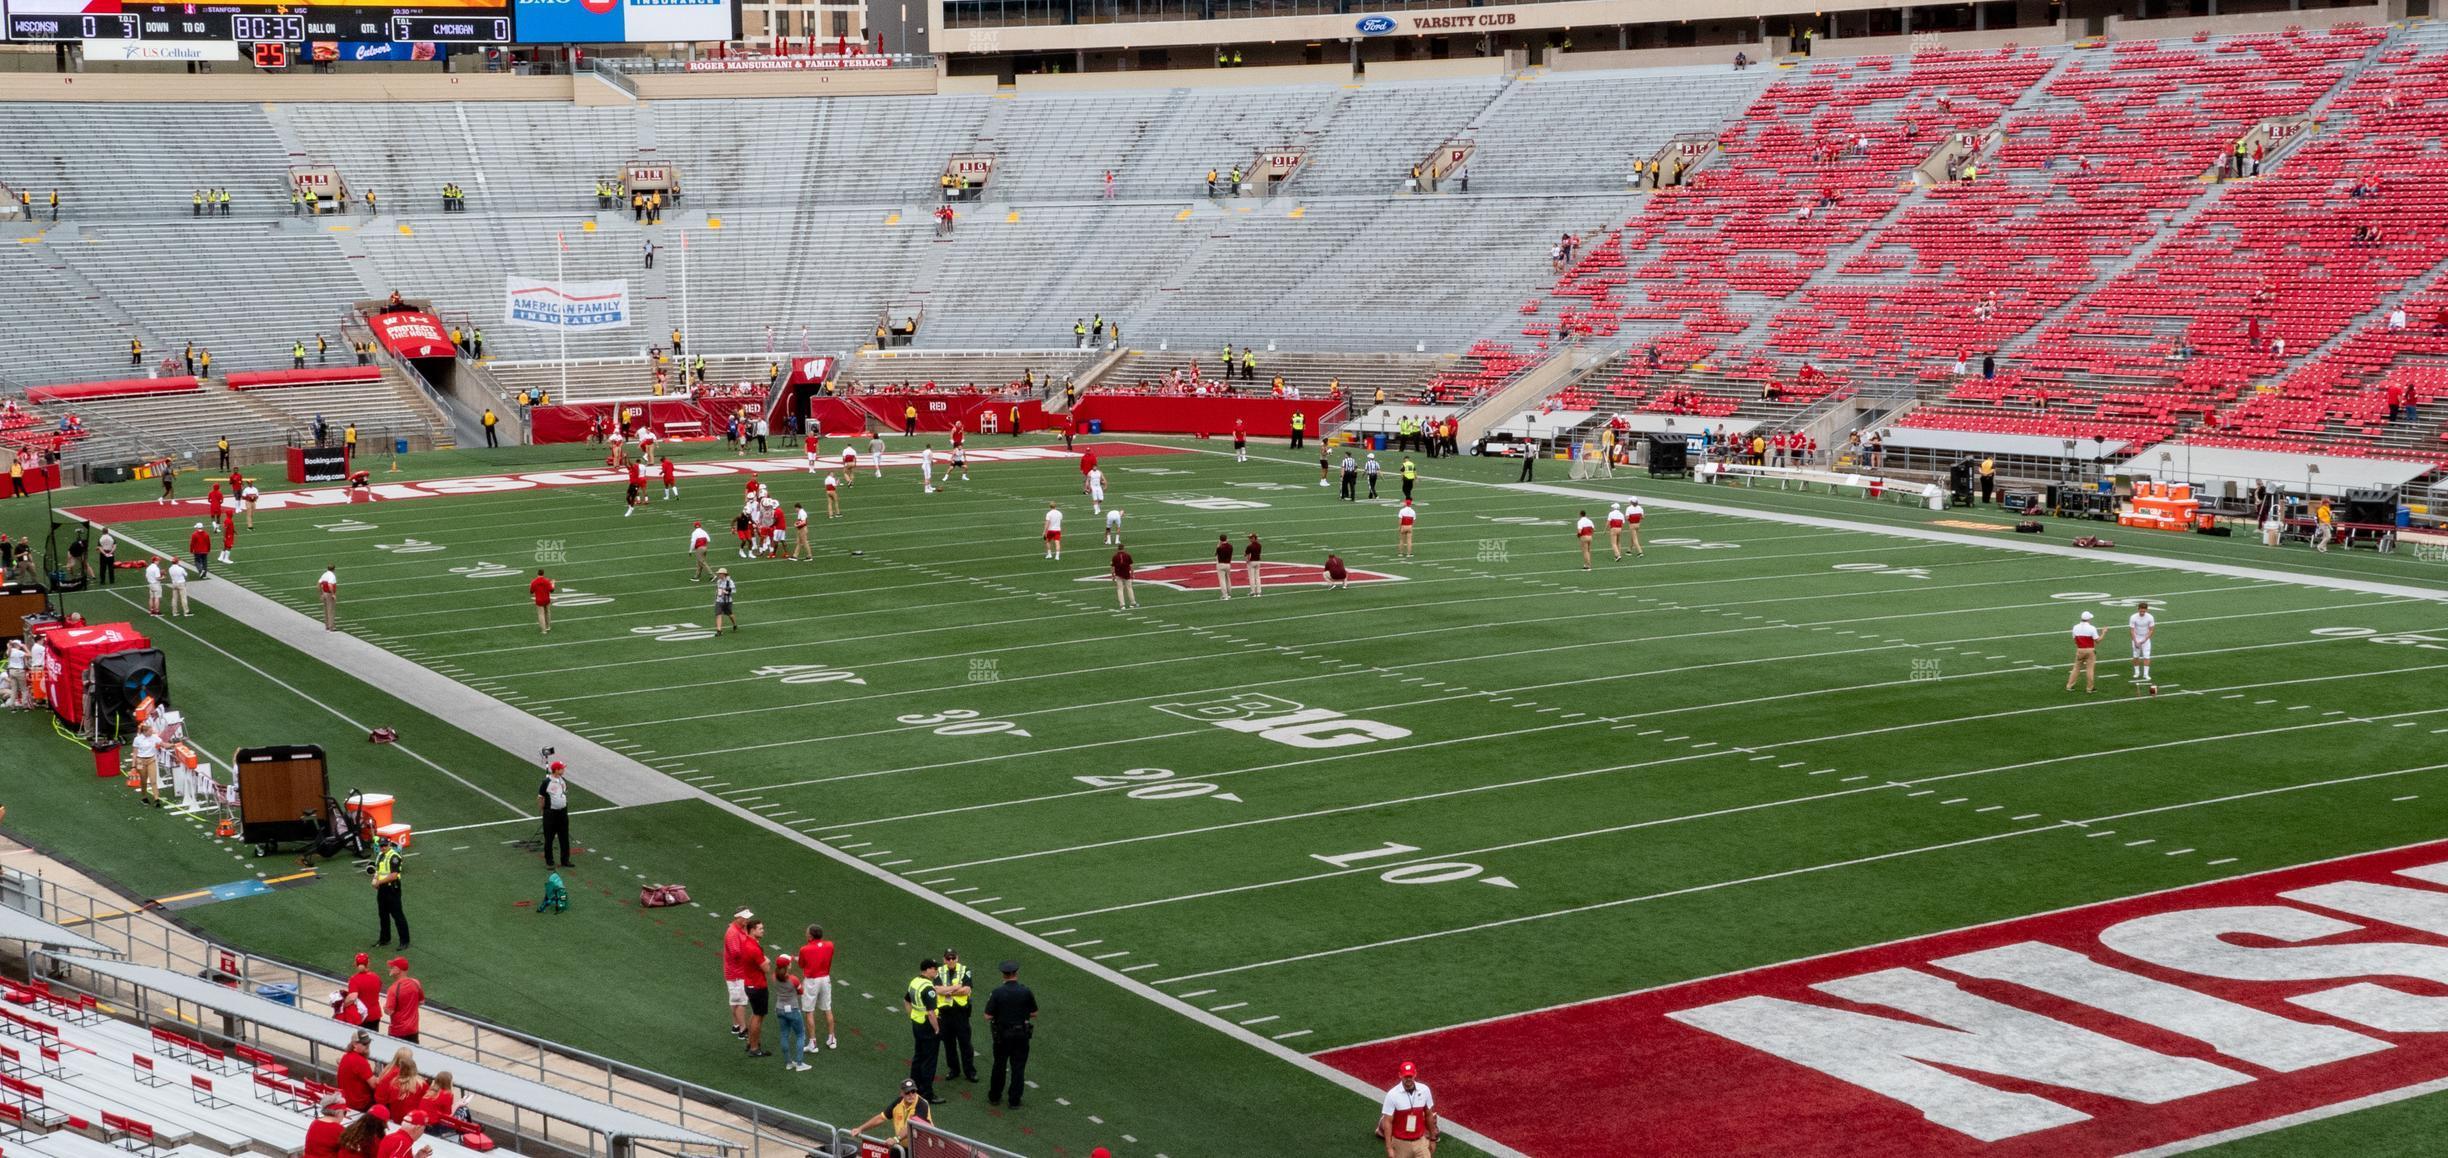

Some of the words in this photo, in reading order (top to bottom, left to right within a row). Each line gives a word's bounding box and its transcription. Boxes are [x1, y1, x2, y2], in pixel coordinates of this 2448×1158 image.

[15, 21, 58, 32] WISCONSIN
[82, 16, 96, 38] 0
[146, 22, 169, 33] DOWN
[182, 22, 194, 33] TO
[194, 22, 206, 33] GO
[236, 17, 300, 39] 80:35
[1363, 19, 1388, 32] Ford
[1413, 16, 1475, 29] VARSITY
[1479, 13, 1516, 26] CLUB
[123, 23, 132, 38] 3
[307, 24, 324, 34] BALL
[325, 24, 336, 34] ON
[361, 23, 378, 34] QTR.
[384, 22, 389, 36] 1
[401, 25, 409, 40] 3
[433, 24, 474, 35] C.MICHIGAN
[494, 19, 507, 40] 0
[142, 47, 158, 58] US
[160, 46, 202, 58] Cellular
[257, 44, 284, 65] 25
[690, 62, 725, 70] ROGER
[727, 60, 792, 70] MANSUKHANI
[794, 60, 803, 68] &
[805, 59, 840, 68] FAMILY
[842, 59, 888, 68] TERRACE
[514, 299, 574, 314] AMERICAN
[578, 301, 620, 314] FAMILY
[520, 312, 613, 324] INSURANCE
[386, 324, 437, 335] PROTECT
[803, 358, 826, 380] W
[929, 401, 947, 411] RED
[304, 457, 345, 465] Booking.com
[305, 474, 346, 482] Booking.com
[448, 563, 524, 578] 30
[630, 624, 718, 641] 50
[750, 664, 855, 684] 40
[897, 709, 1016, 735] 30
[1073, 767, 1220, 800] 20
[1310, 842, 1484, 884] 10
[862, 1143, 889, 1155] EMERGENCY
